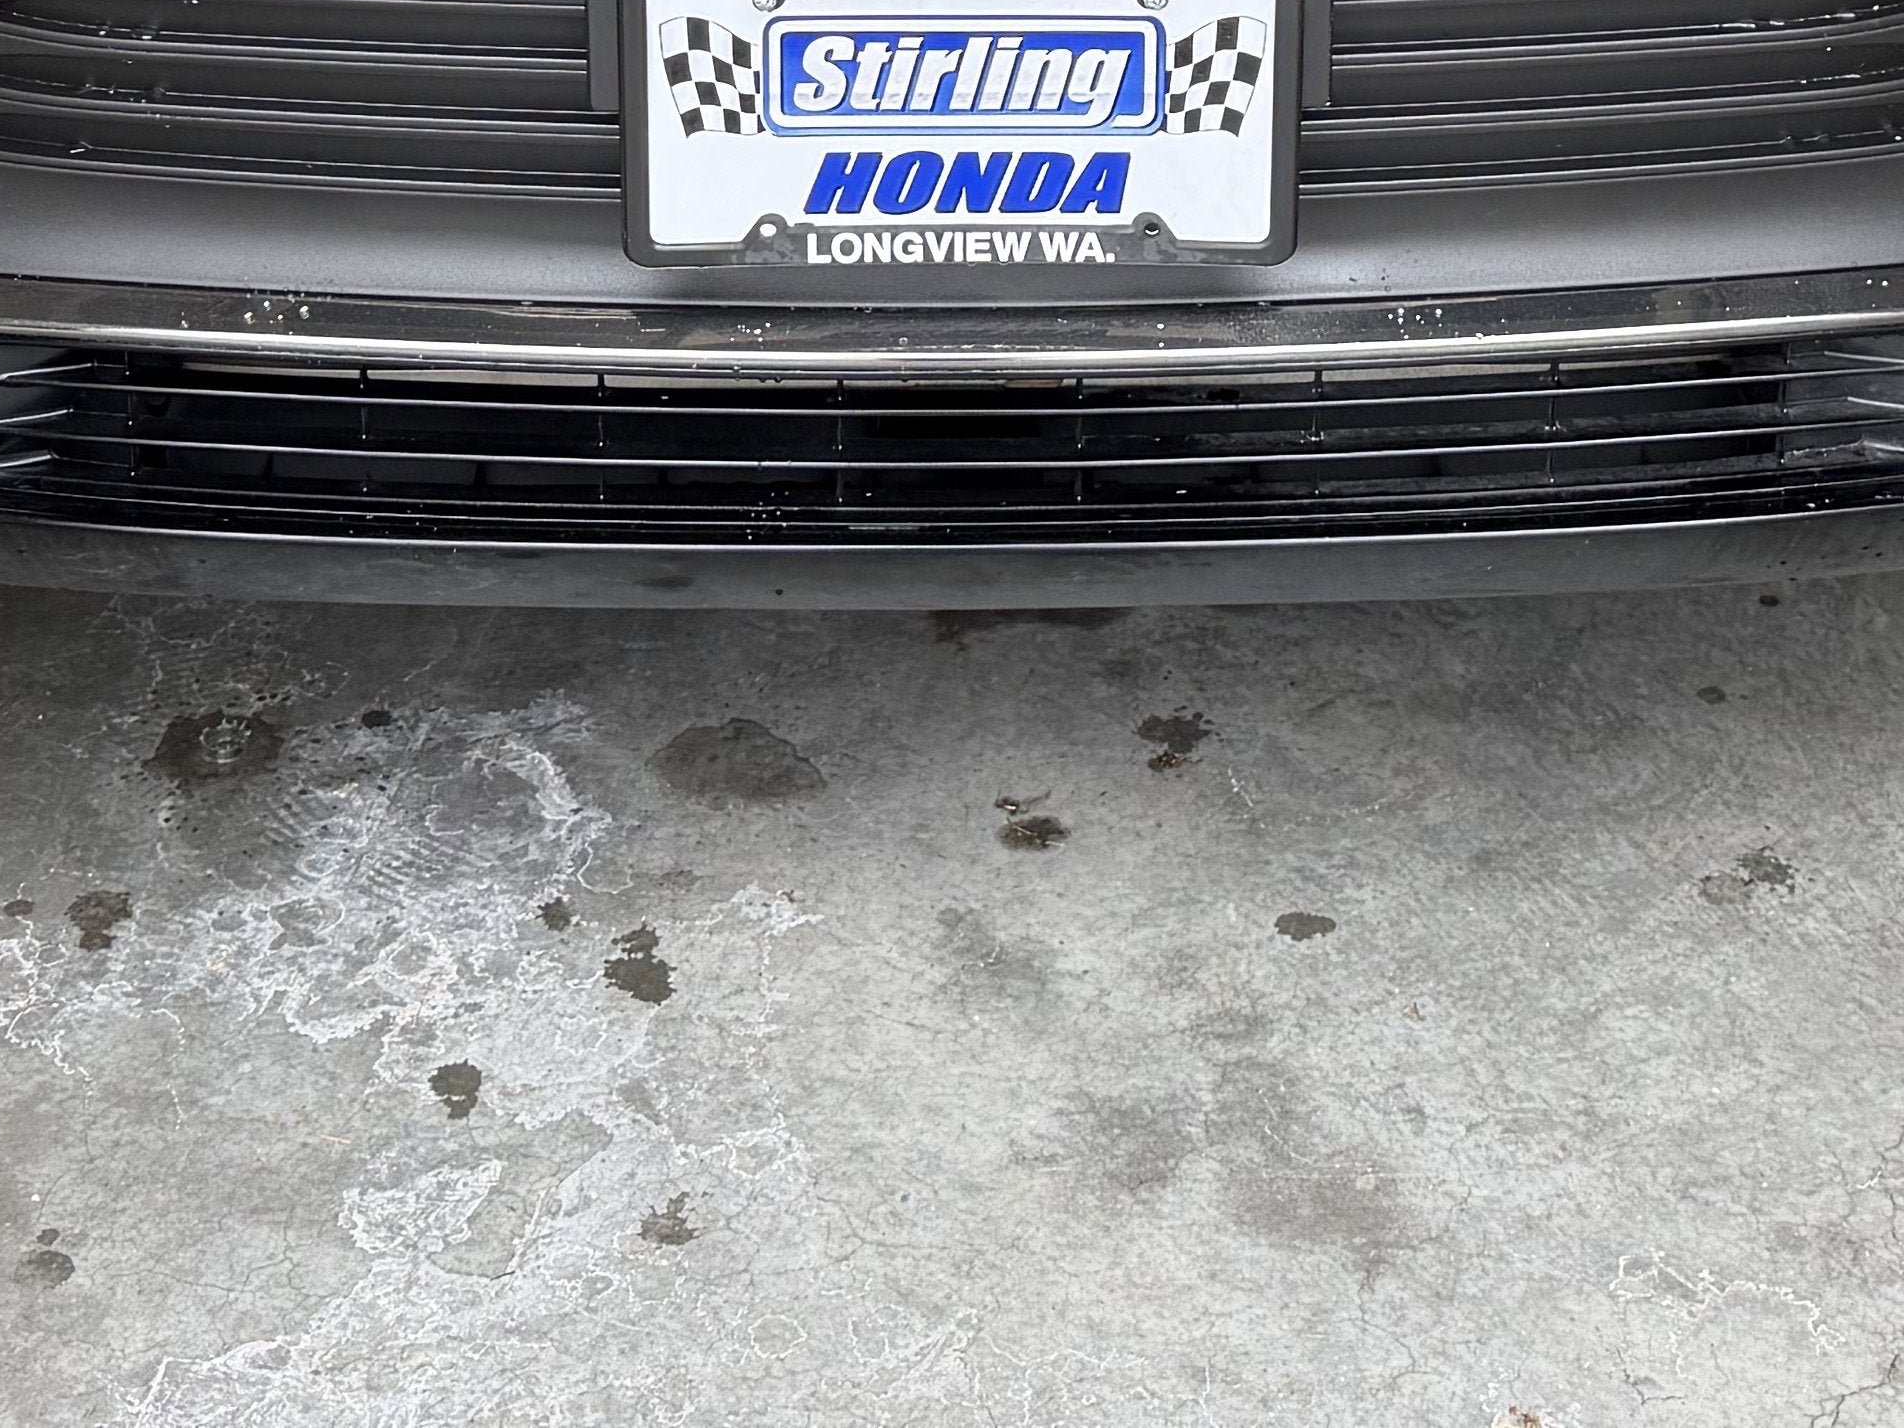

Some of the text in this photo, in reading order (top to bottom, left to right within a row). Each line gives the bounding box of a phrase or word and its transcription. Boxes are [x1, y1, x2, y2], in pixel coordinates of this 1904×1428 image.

[792, 35, 1133, 124] Stirling
[803, 150, 1132, 215] HONDA
[806, 231, 1116, 265] LONGVIEW WA.
